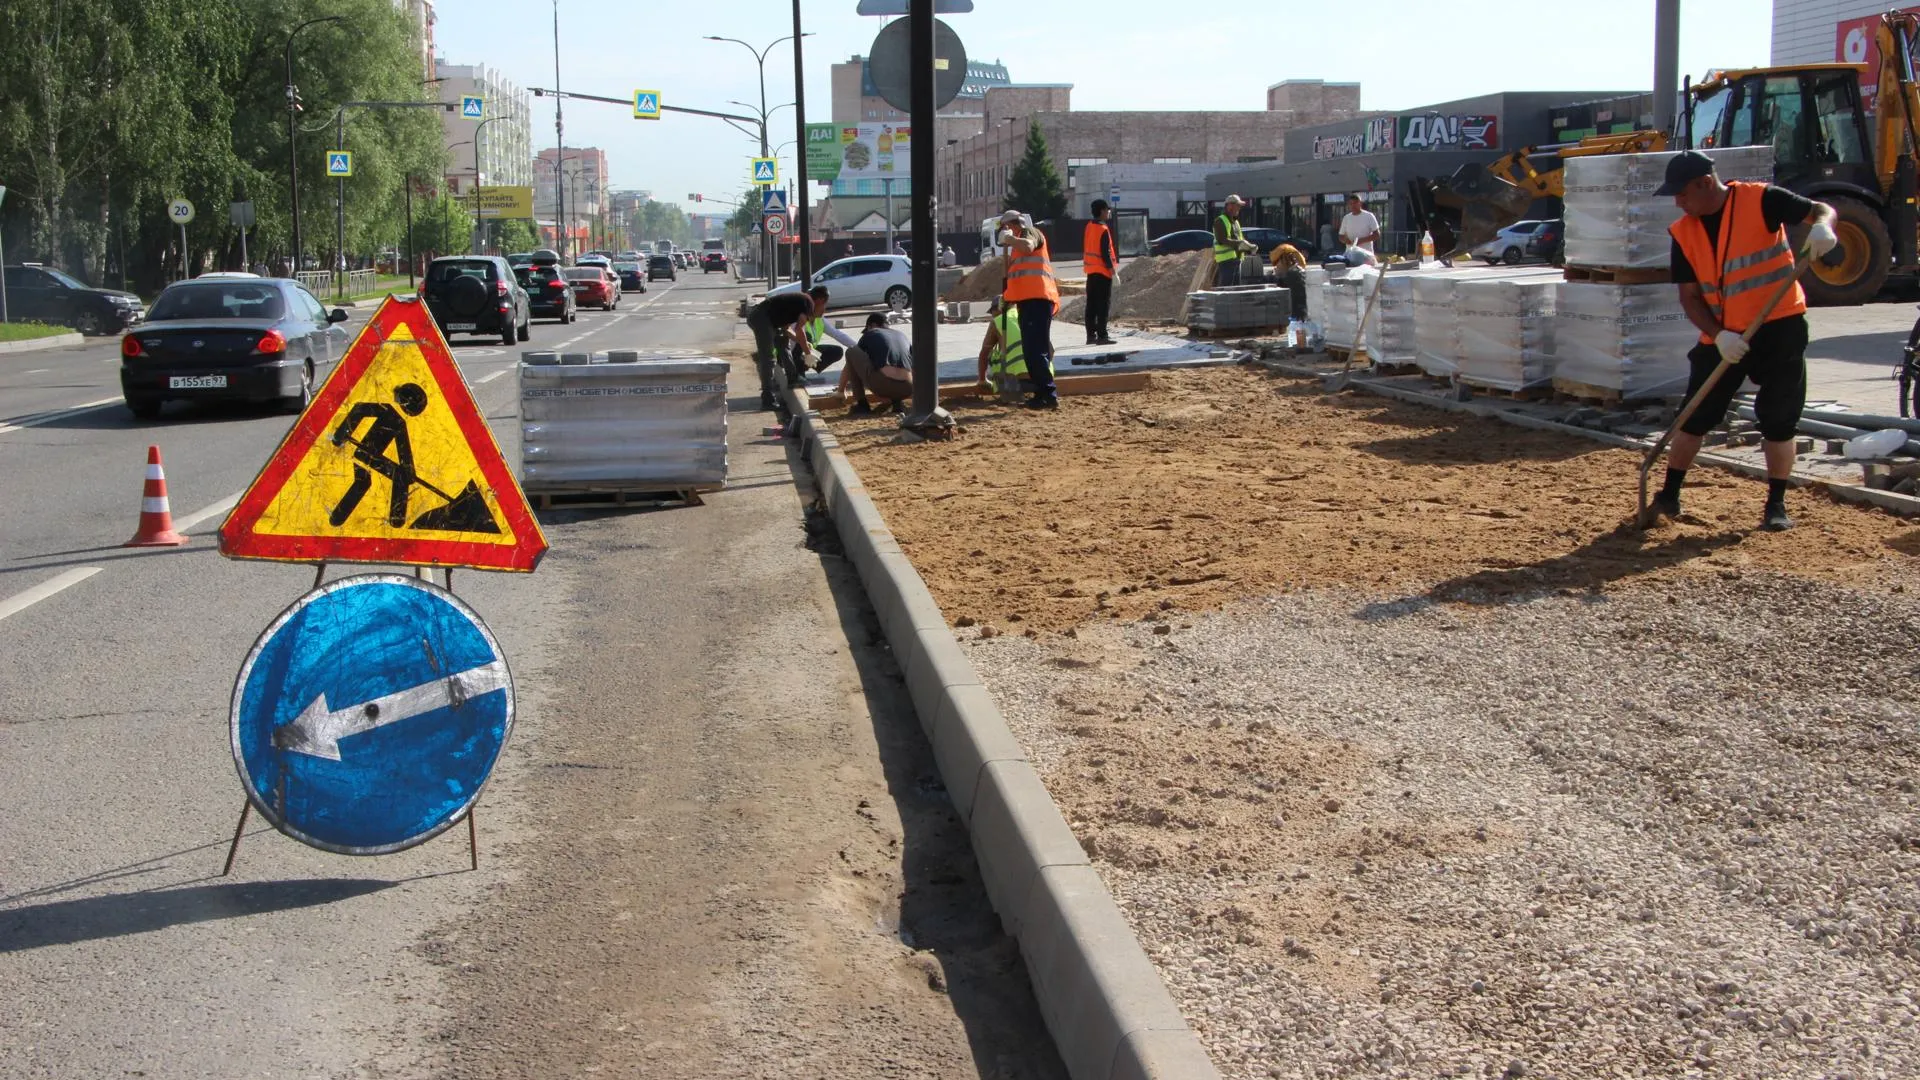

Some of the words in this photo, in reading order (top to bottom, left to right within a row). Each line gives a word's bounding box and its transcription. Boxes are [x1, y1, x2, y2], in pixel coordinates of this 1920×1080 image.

[810, 128, 832, 141] ДА!
[1367, 118, 1383, 151] ДА!
[1403, 116, 1459, 148] ДА!
[174, 206, 189, 216] 20
[770, 220, 782, 229] 20
